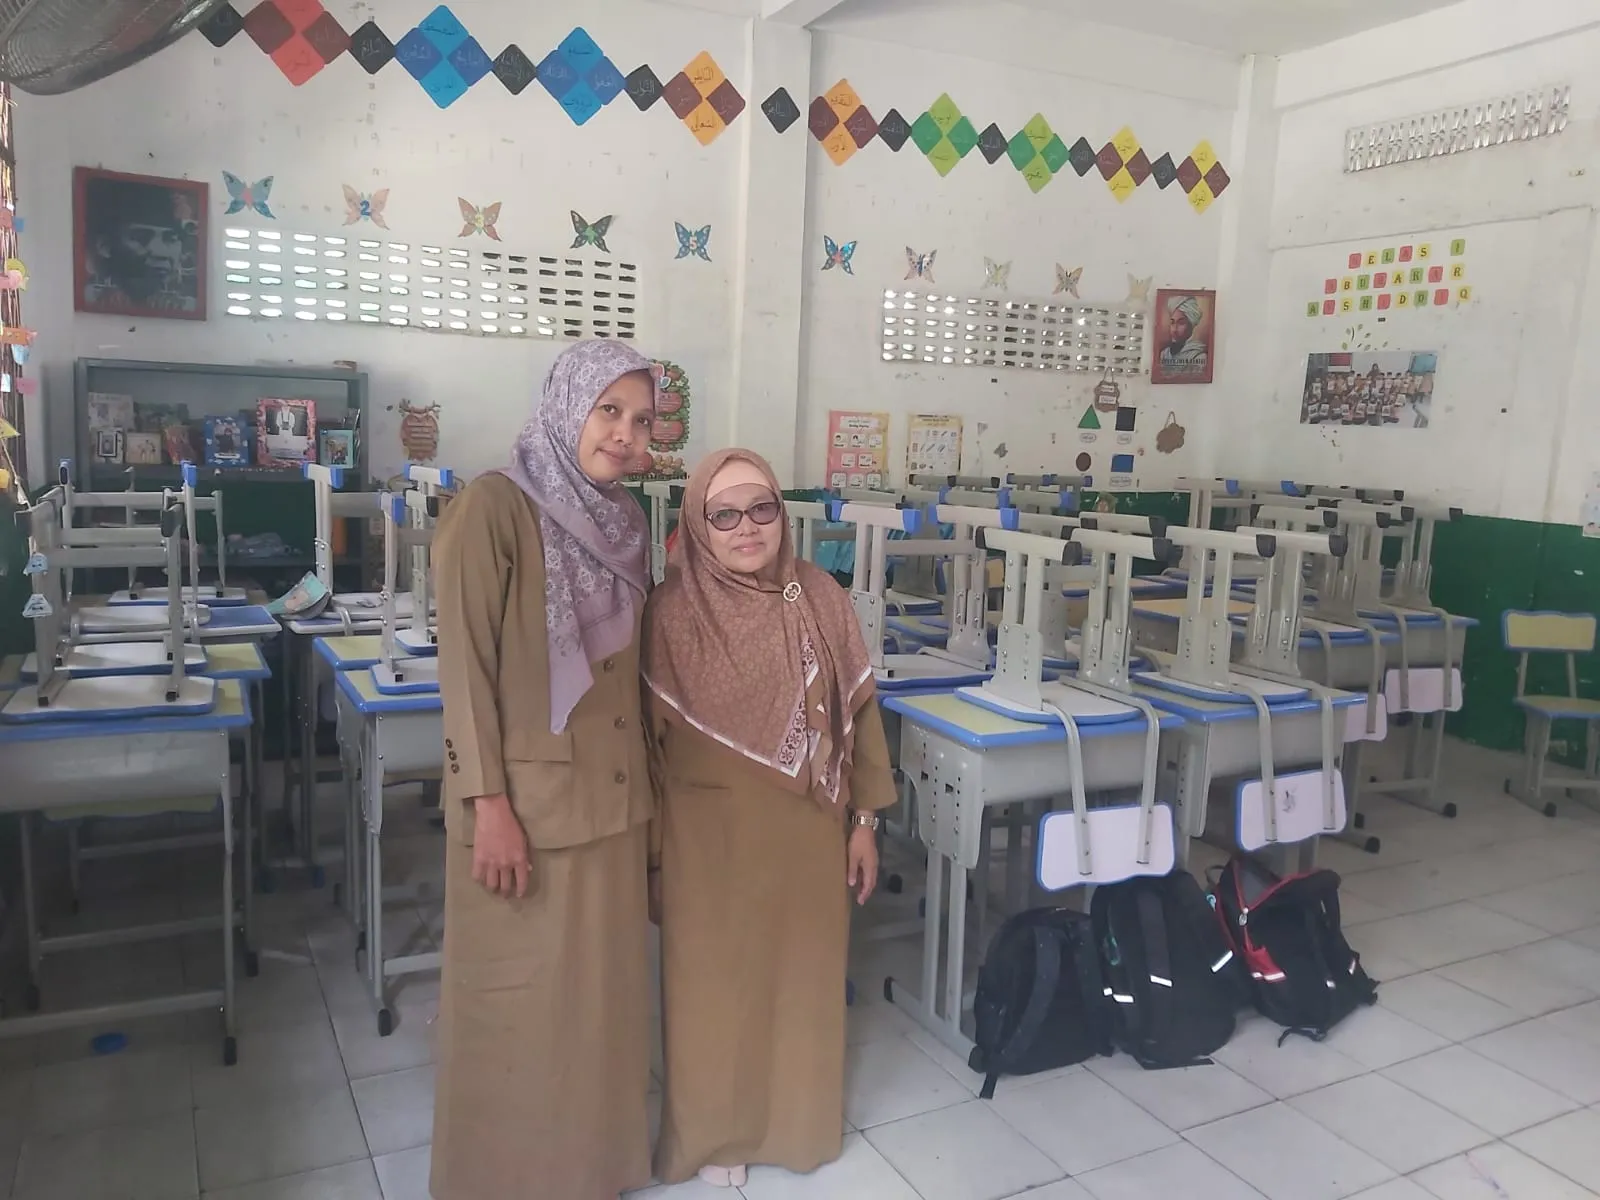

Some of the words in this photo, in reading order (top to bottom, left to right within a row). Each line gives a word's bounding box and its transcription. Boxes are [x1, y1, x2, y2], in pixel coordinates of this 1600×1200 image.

[360, 200, 370, 216] 2
[689, 236, 698, 249] 5
[1350, 246, 1429, 266] KELAS
